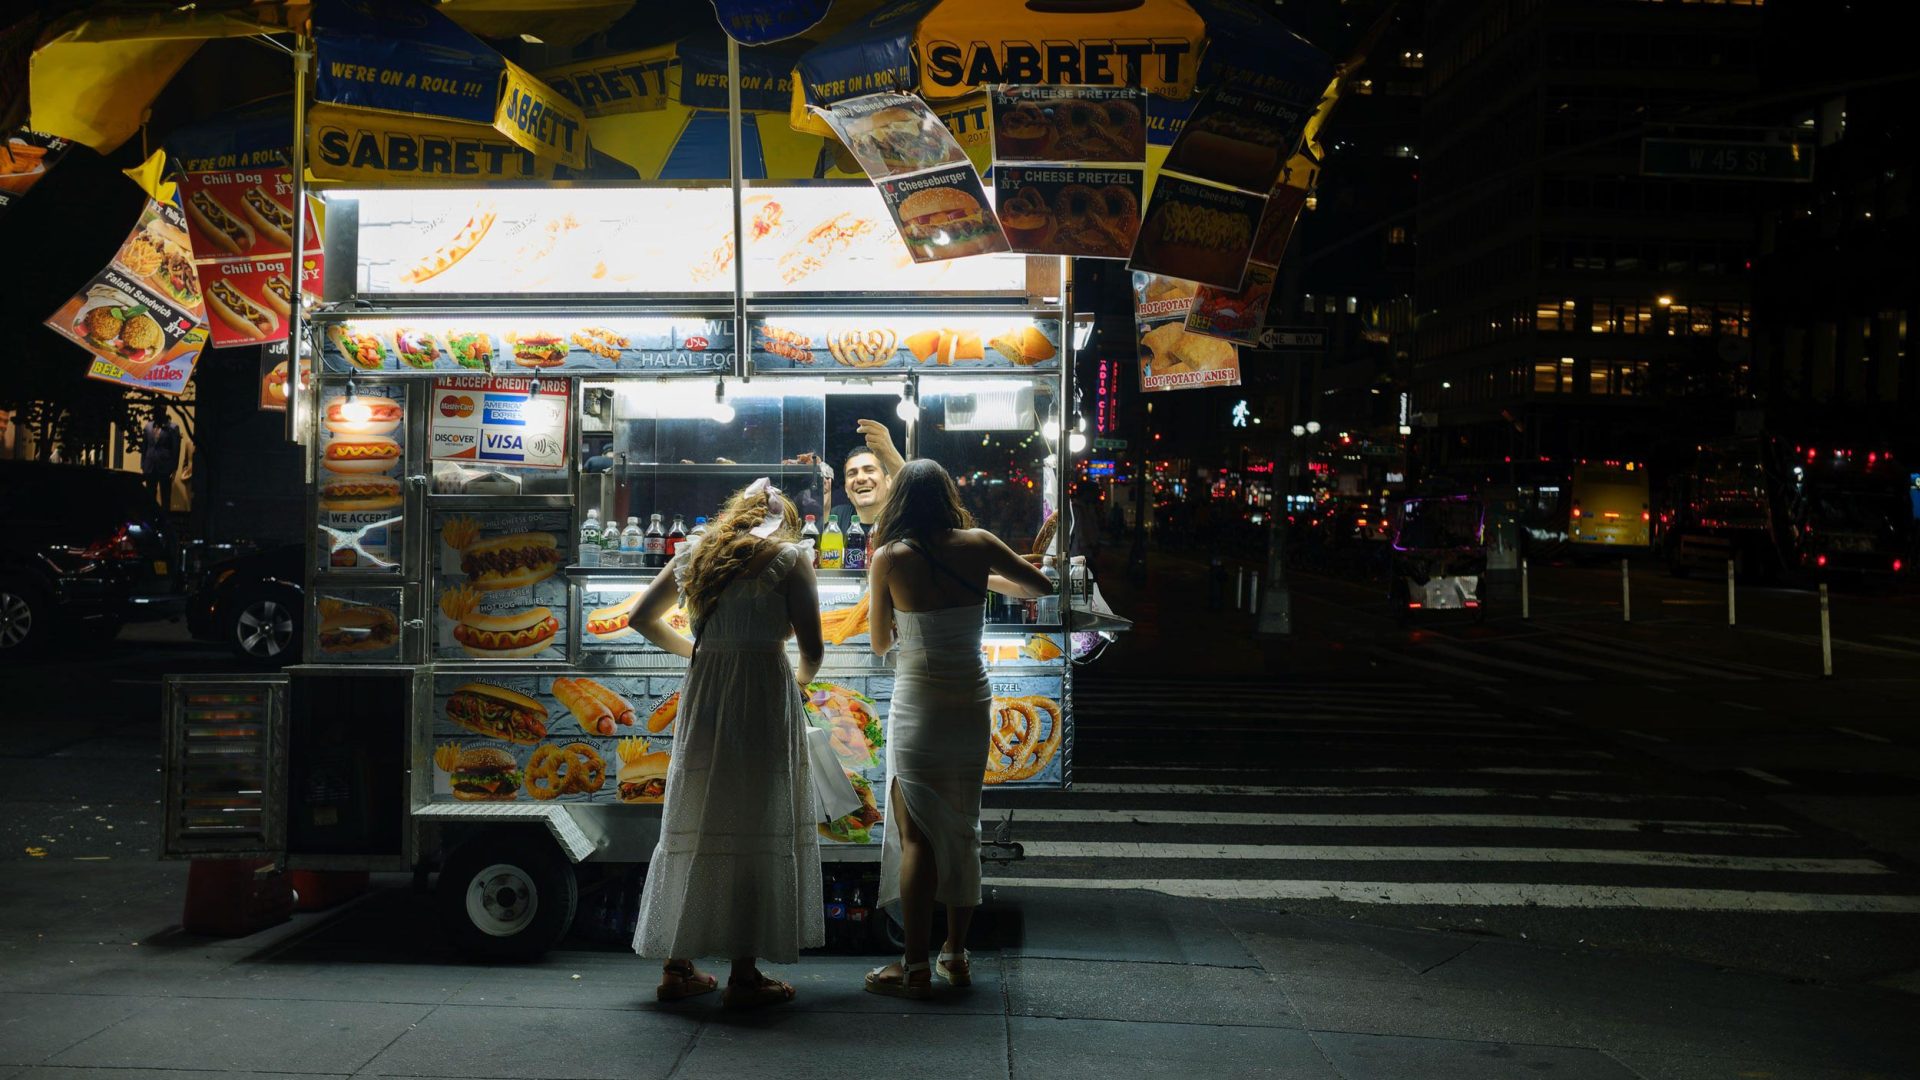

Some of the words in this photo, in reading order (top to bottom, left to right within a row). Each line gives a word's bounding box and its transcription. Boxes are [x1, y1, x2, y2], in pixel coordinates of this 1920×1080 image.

[927, 38, 1191, 87] SABRETT
[331, 62, 376, 81] WE'RE
[380, 70, 400, 87] ON
[405, 74, 416, 88] A
[422, 76, 457, 96] ROLL
[463, 82, 482, 99] !!!
[695, 73, 729, 89] WE'R
[741, 74, 761, 90] ON
[764, 75, 773, 91] A
[817, 80, 846, 98] WE'RE
[849, 76, 862, 92] ON
[865, 73, 873, 89] A
[1022, 89, 1074, 99] CHEESE
[1078, 88, 1136, 99] PRETZEL
[1154, 86, 1178, 97] 2019
[853, 101, 883, 113] Cheese
[1254, 101, 1274, 115] Hot
[1276, 106, 1298, 123] Dog
[968, 131, 989, 143] 2017
[319, 126, 536, 176] SABRETT
[187, 158, 215, 171] E'RE
[218, 154, 236, 168] ON
[241, 153, 249, 166] A
[1688, 149, 1704, 168] W
[1713, 149, 1737, 170] 45
[1745, 151, 1768, 172] St
[202, 174, 232, 185] Chili
[236, 172, 262, 184] Dog
[900, 171, 967, 191] Cheeseburger
[1024, 171, 1075, 183] CHEESE
[1077, 172, 1134, 184] PRETZEL
[221, 264, 253, 275] Chili
[256, 262, 285, 272] Dog
[105, 272, 134, 294] Falafel
[133, 288, 172, 318] Sandwich
[1140, 302, 1159, 314] HOT
[164, 322, 186, 338] NY
[1264, 334, 1285, 345] ONE
[1295, 334, 1319, 345] WAY
[641, 352, 698, 366] HALAL
[141, 364, 184, 382] atties
[1144, 376, 1163, 387] HOT
[1165, 372, 1201, 385] POTATO
[1204, 368, 1236, 381] KNISH
[438, 376, 453, 387] WE
[455, 376, 495, 389] ACCEPT
[495, 377, 530, 391] CREDIT
[541, 380, 567, 392] ARDS
[441, 402, 475, 411] MasterCard
[1097, 400, 1106, 432] CITY
[435, 433, 475, 444] DISCOVER
[486, 434, 523, 450] VISA
[331, 513, 347, 523] WE
[350, 513, 388, 523] ACCEPT
[528, 513, 544, 522] DOG
[498, 601, 515, 610] DOG
[475, 677, 502, 688] ITALIAN
[502, 682, 536, 699] SAUSAGE
[992, 683, 1021, 693] ETZEL
[650, 698, 662, 712] CORN
[662, 689, 676, 701] DOG
